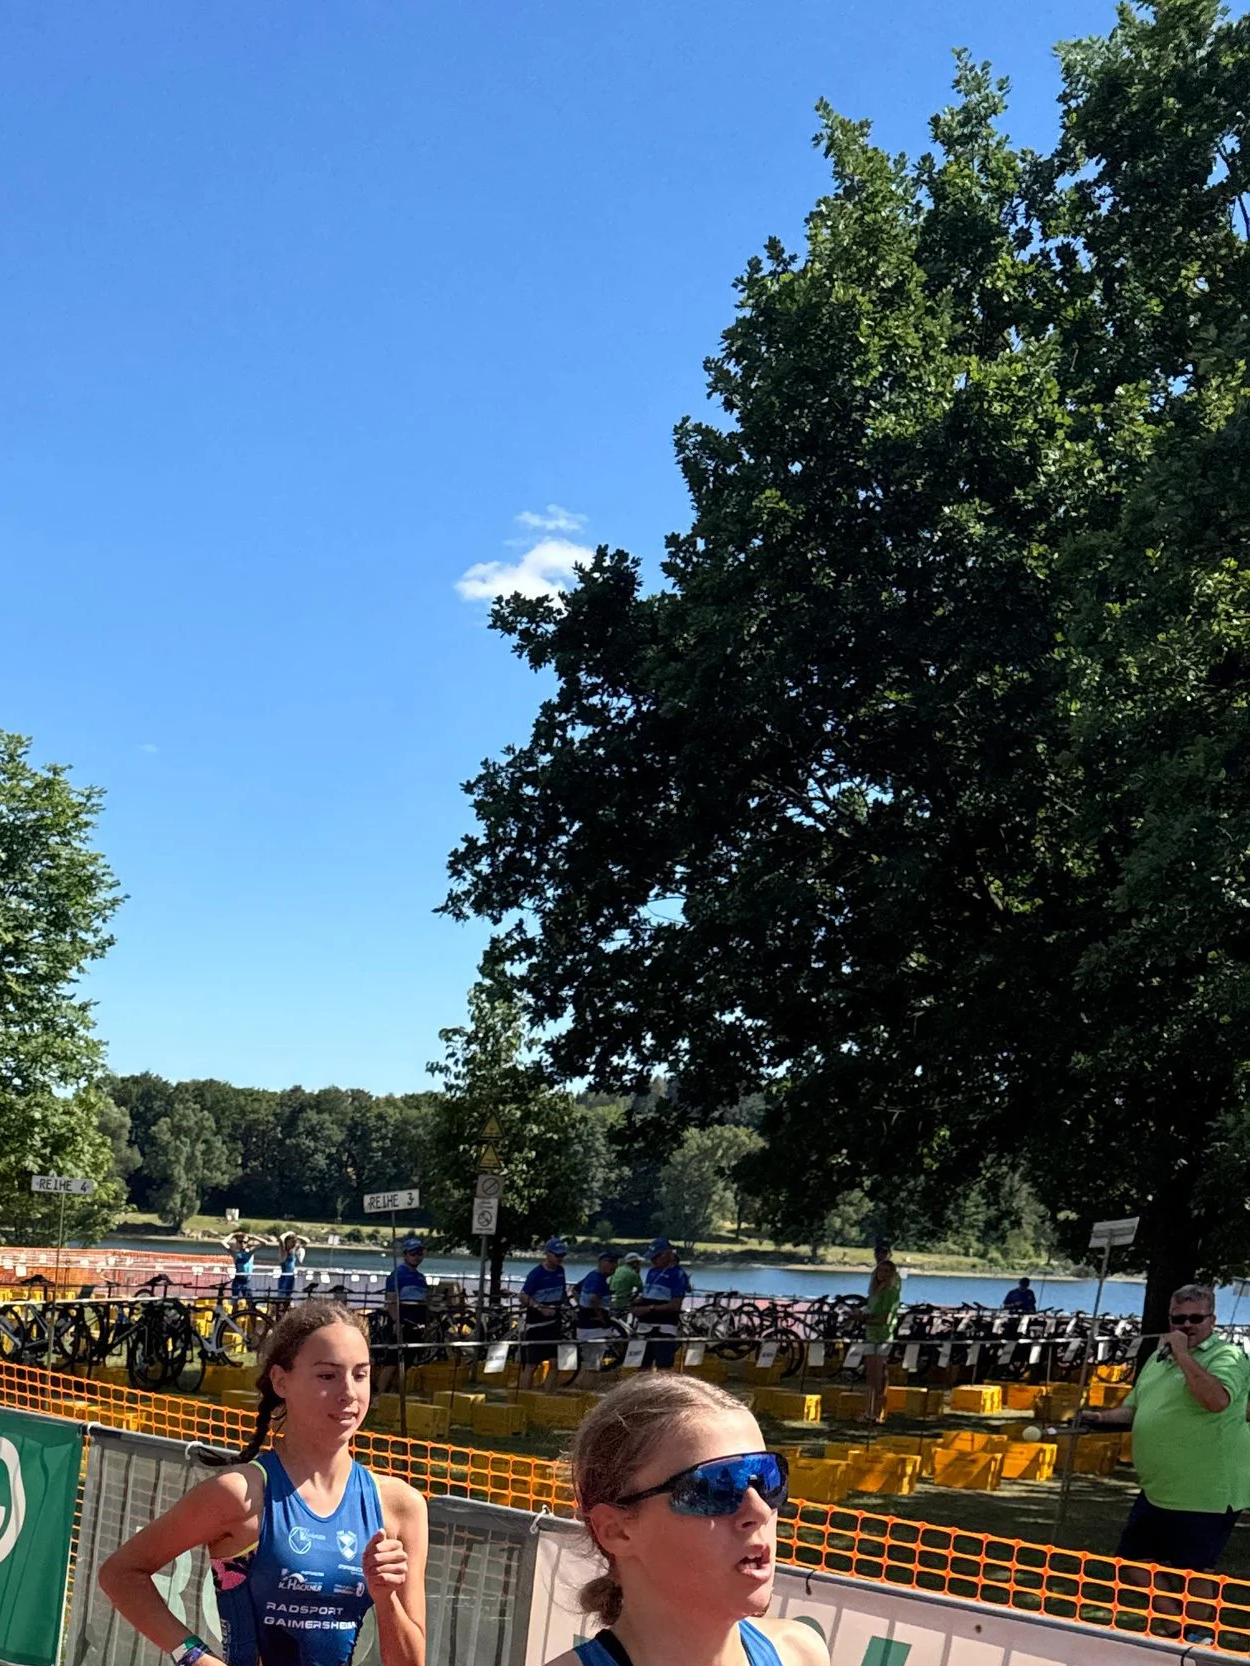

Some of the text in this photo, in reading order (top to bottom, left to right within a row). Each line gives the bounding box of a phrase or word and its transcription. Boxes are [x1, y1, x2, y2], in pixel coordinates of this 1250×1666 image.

[39, 1178, 88, 1193] REIHE 4
[369, 1193, 400, 1210] REIHE
[265, 1601, 345, 1616] RADSPORT
[263, 1616, 357, 1630] GAIMERSHEIM
